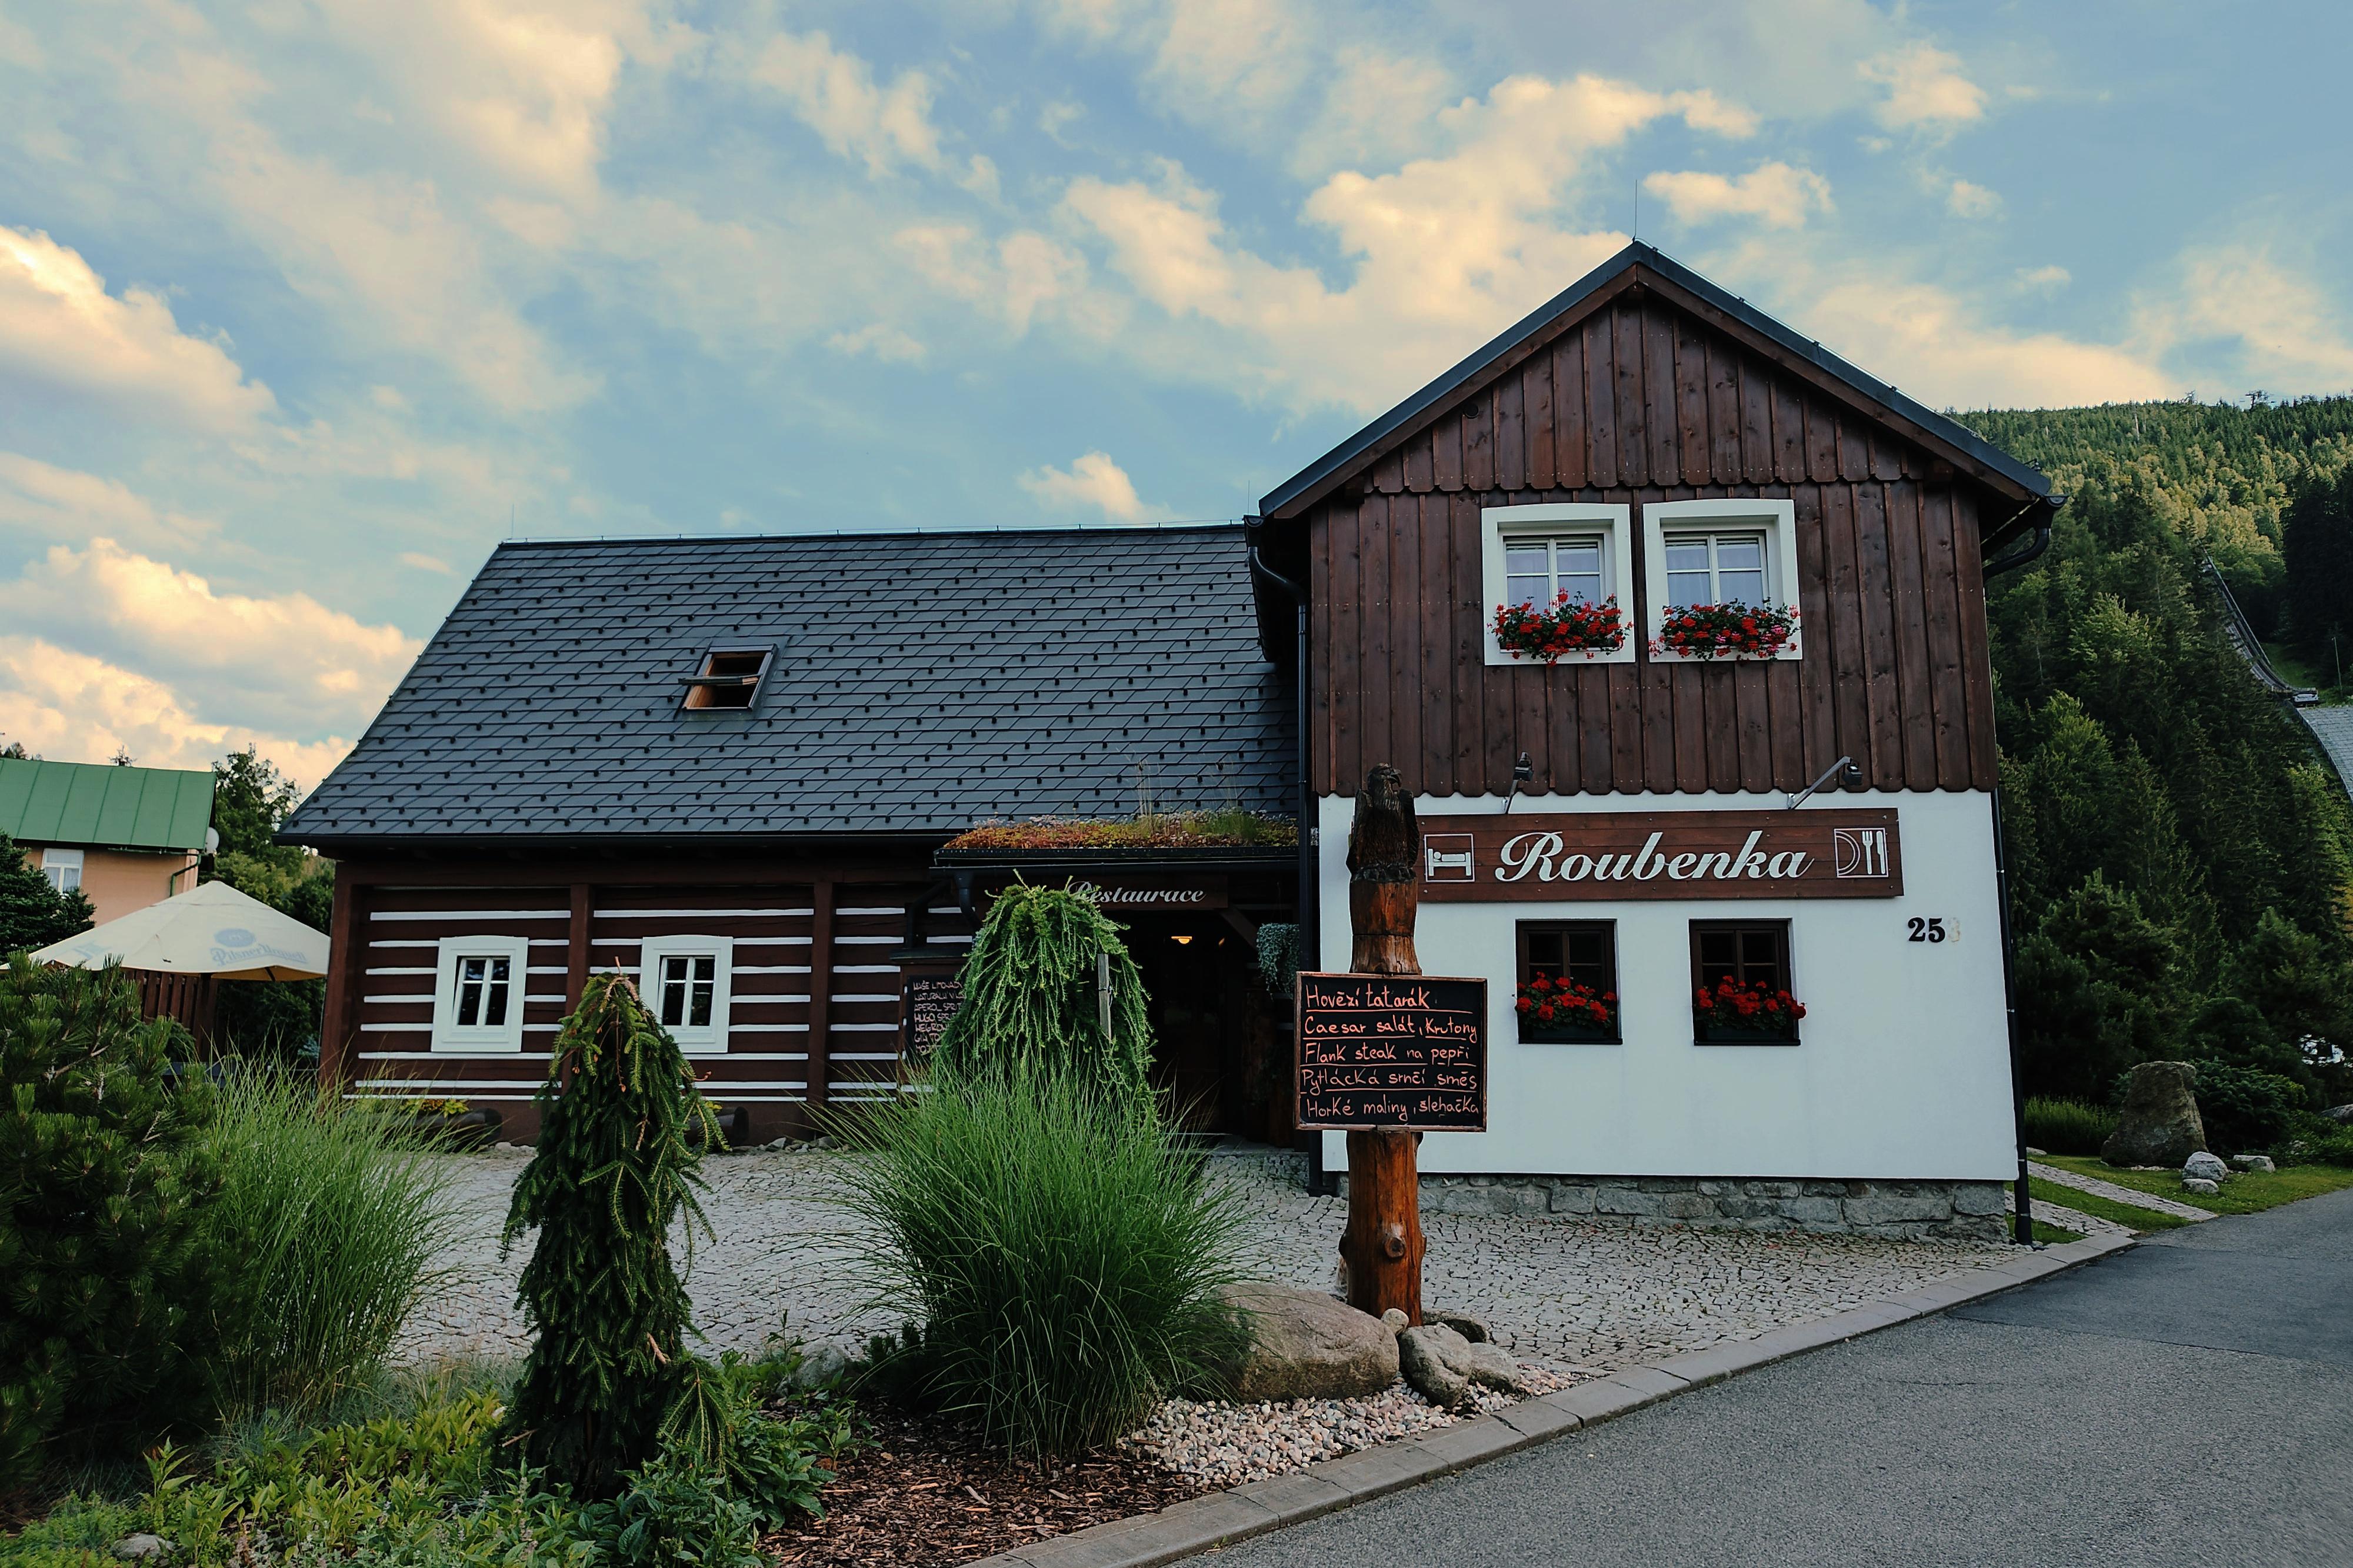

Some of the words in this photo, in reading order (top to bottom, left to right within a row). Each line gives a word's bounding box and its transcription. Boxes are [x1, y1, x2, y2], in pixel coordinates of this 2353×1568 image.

[1495, 830, 1815, 882] Roubenka
[209, 946, 262, 966] Pilsner
[258, 943, 308, 962] Urquell
[1305, 984, 1360, 1008] Hovězí
[1365, 983, 1431, 1009] tatarák
[914, 1012, 935, 1023] HUGO
[1305, 1016, 1367, 1035] Caesar
[1305, 1042, 1347, 1063] Flank
[1355, 1042, 1397, 1060] steak
[1407, 1049, 1423, 1059] na
[1437, 1071, 1477, 1089] směs
